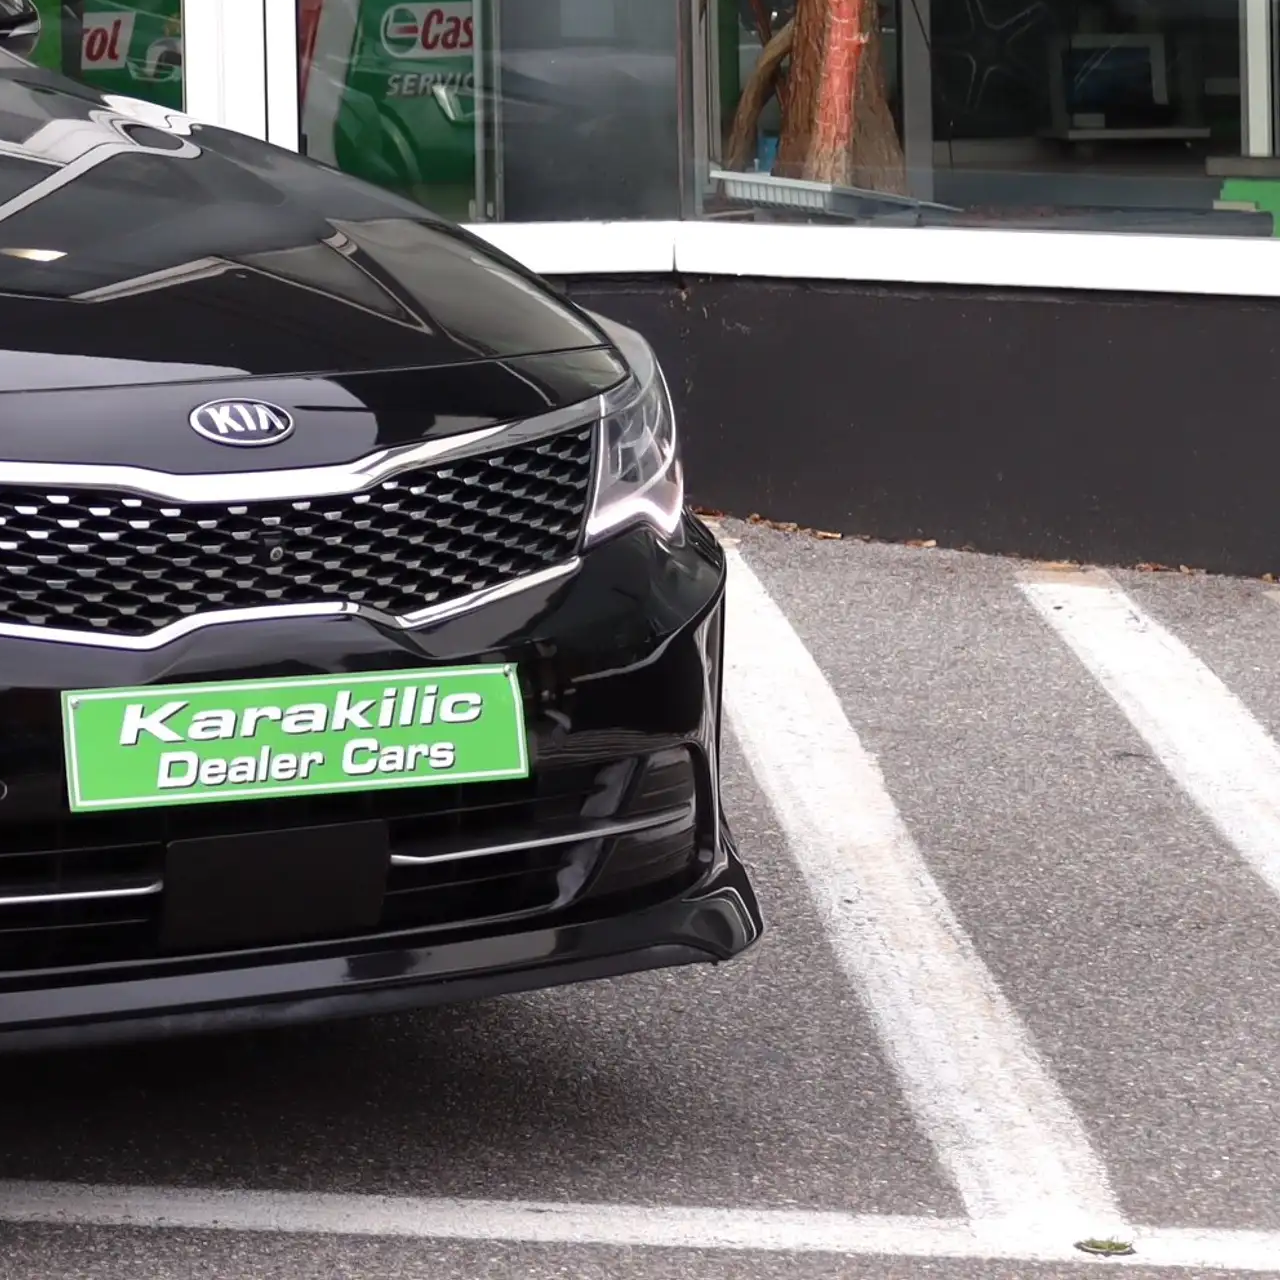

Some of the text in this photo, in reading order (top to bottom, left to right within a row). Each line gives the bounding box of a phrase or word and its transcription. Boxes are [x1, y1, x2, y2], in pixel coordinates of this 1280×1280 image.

[204, 402, 288, 434] KIA
[119, 684, 484, 746] Karakilic
[157, 736, 457, 789] Dealer Cars
